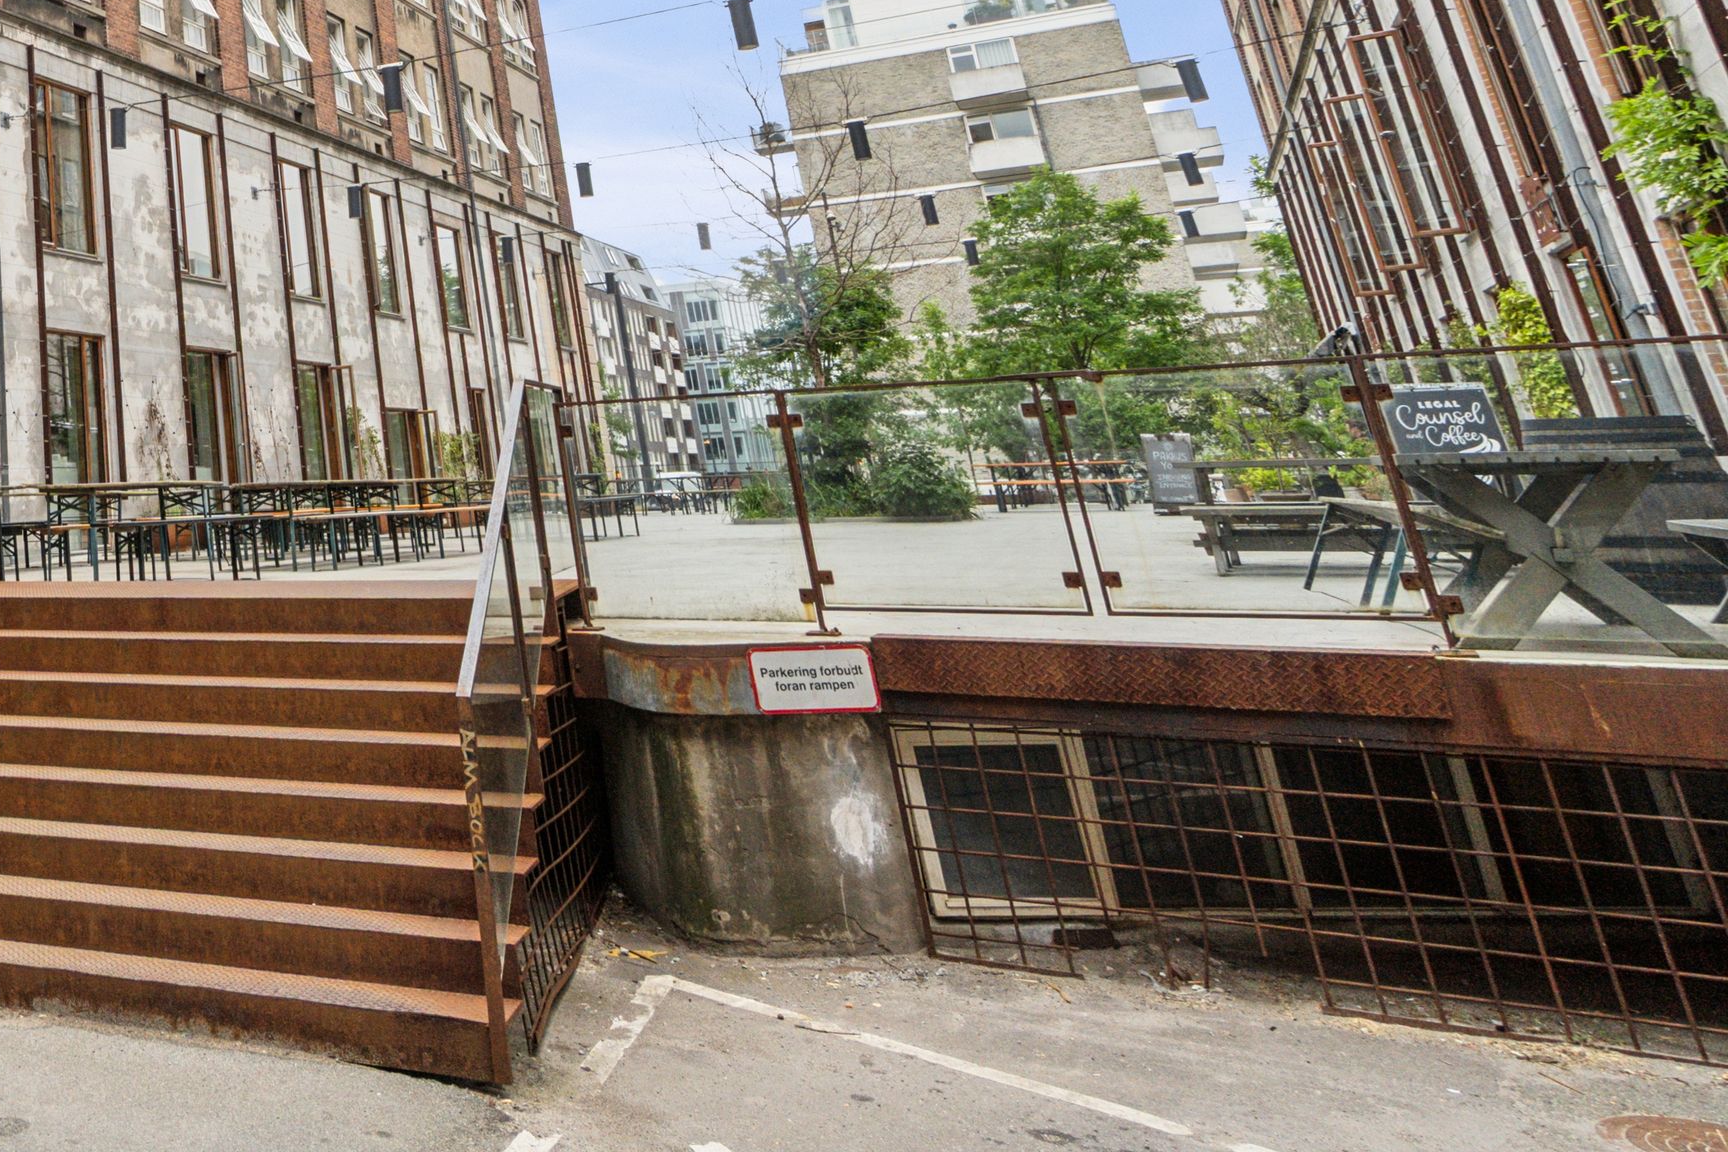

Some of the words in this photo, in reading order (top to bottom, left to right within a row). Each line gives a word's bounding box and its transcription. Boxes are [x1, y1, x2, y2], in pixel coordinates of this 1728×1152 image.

[1417, 400, 1461, 409] LEGAL
[1395, 402, 1485, 431] Counsel
[1405, 430, 1425, 439] and
[1425, 425, 1482, 447] Coffee
[760, 666, 818, 679] Parkering
[819, 664, 864, 676] forbudt
[775, 680, 807, 692] foran
[809, 680, 855, 692] rampen
